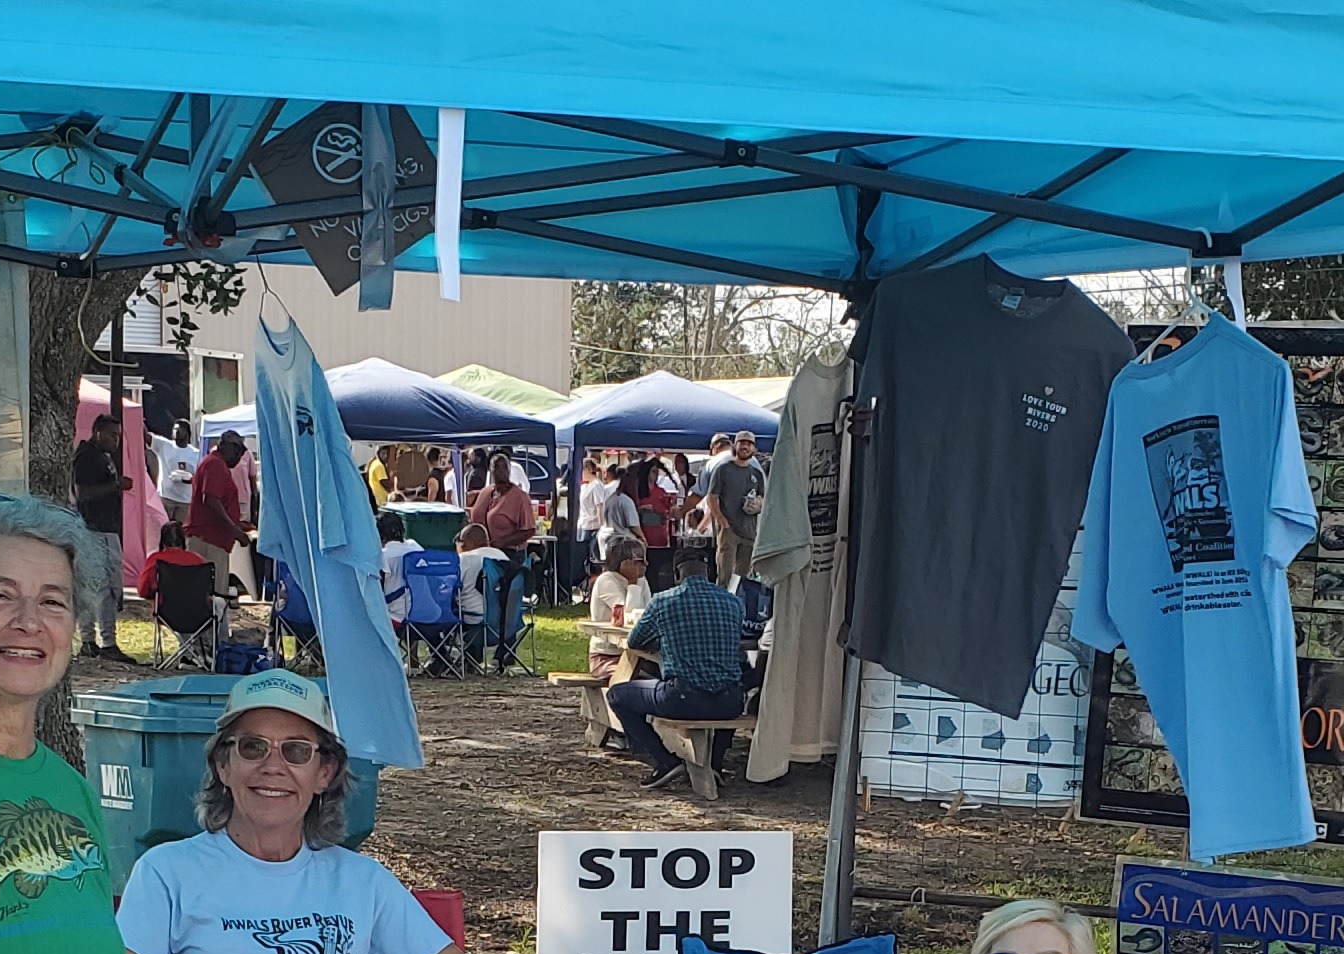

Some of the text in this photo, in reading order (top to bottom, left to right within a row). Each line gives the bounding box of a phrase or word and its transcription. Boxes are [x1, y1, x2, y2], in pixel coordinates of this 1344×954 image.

[1022, 393, 1067, 415] LOVE YOUR
[1026, 406, 1057, 423] RIVERS
[1025, 417, 1049, 432] 2020
[100, 764, 134, 799] WM
[578, 847, 756, 890] STOP
[221, 912, 355, 935] WWALS RIVER REVUE
[600, 910, 731, 952] THE
